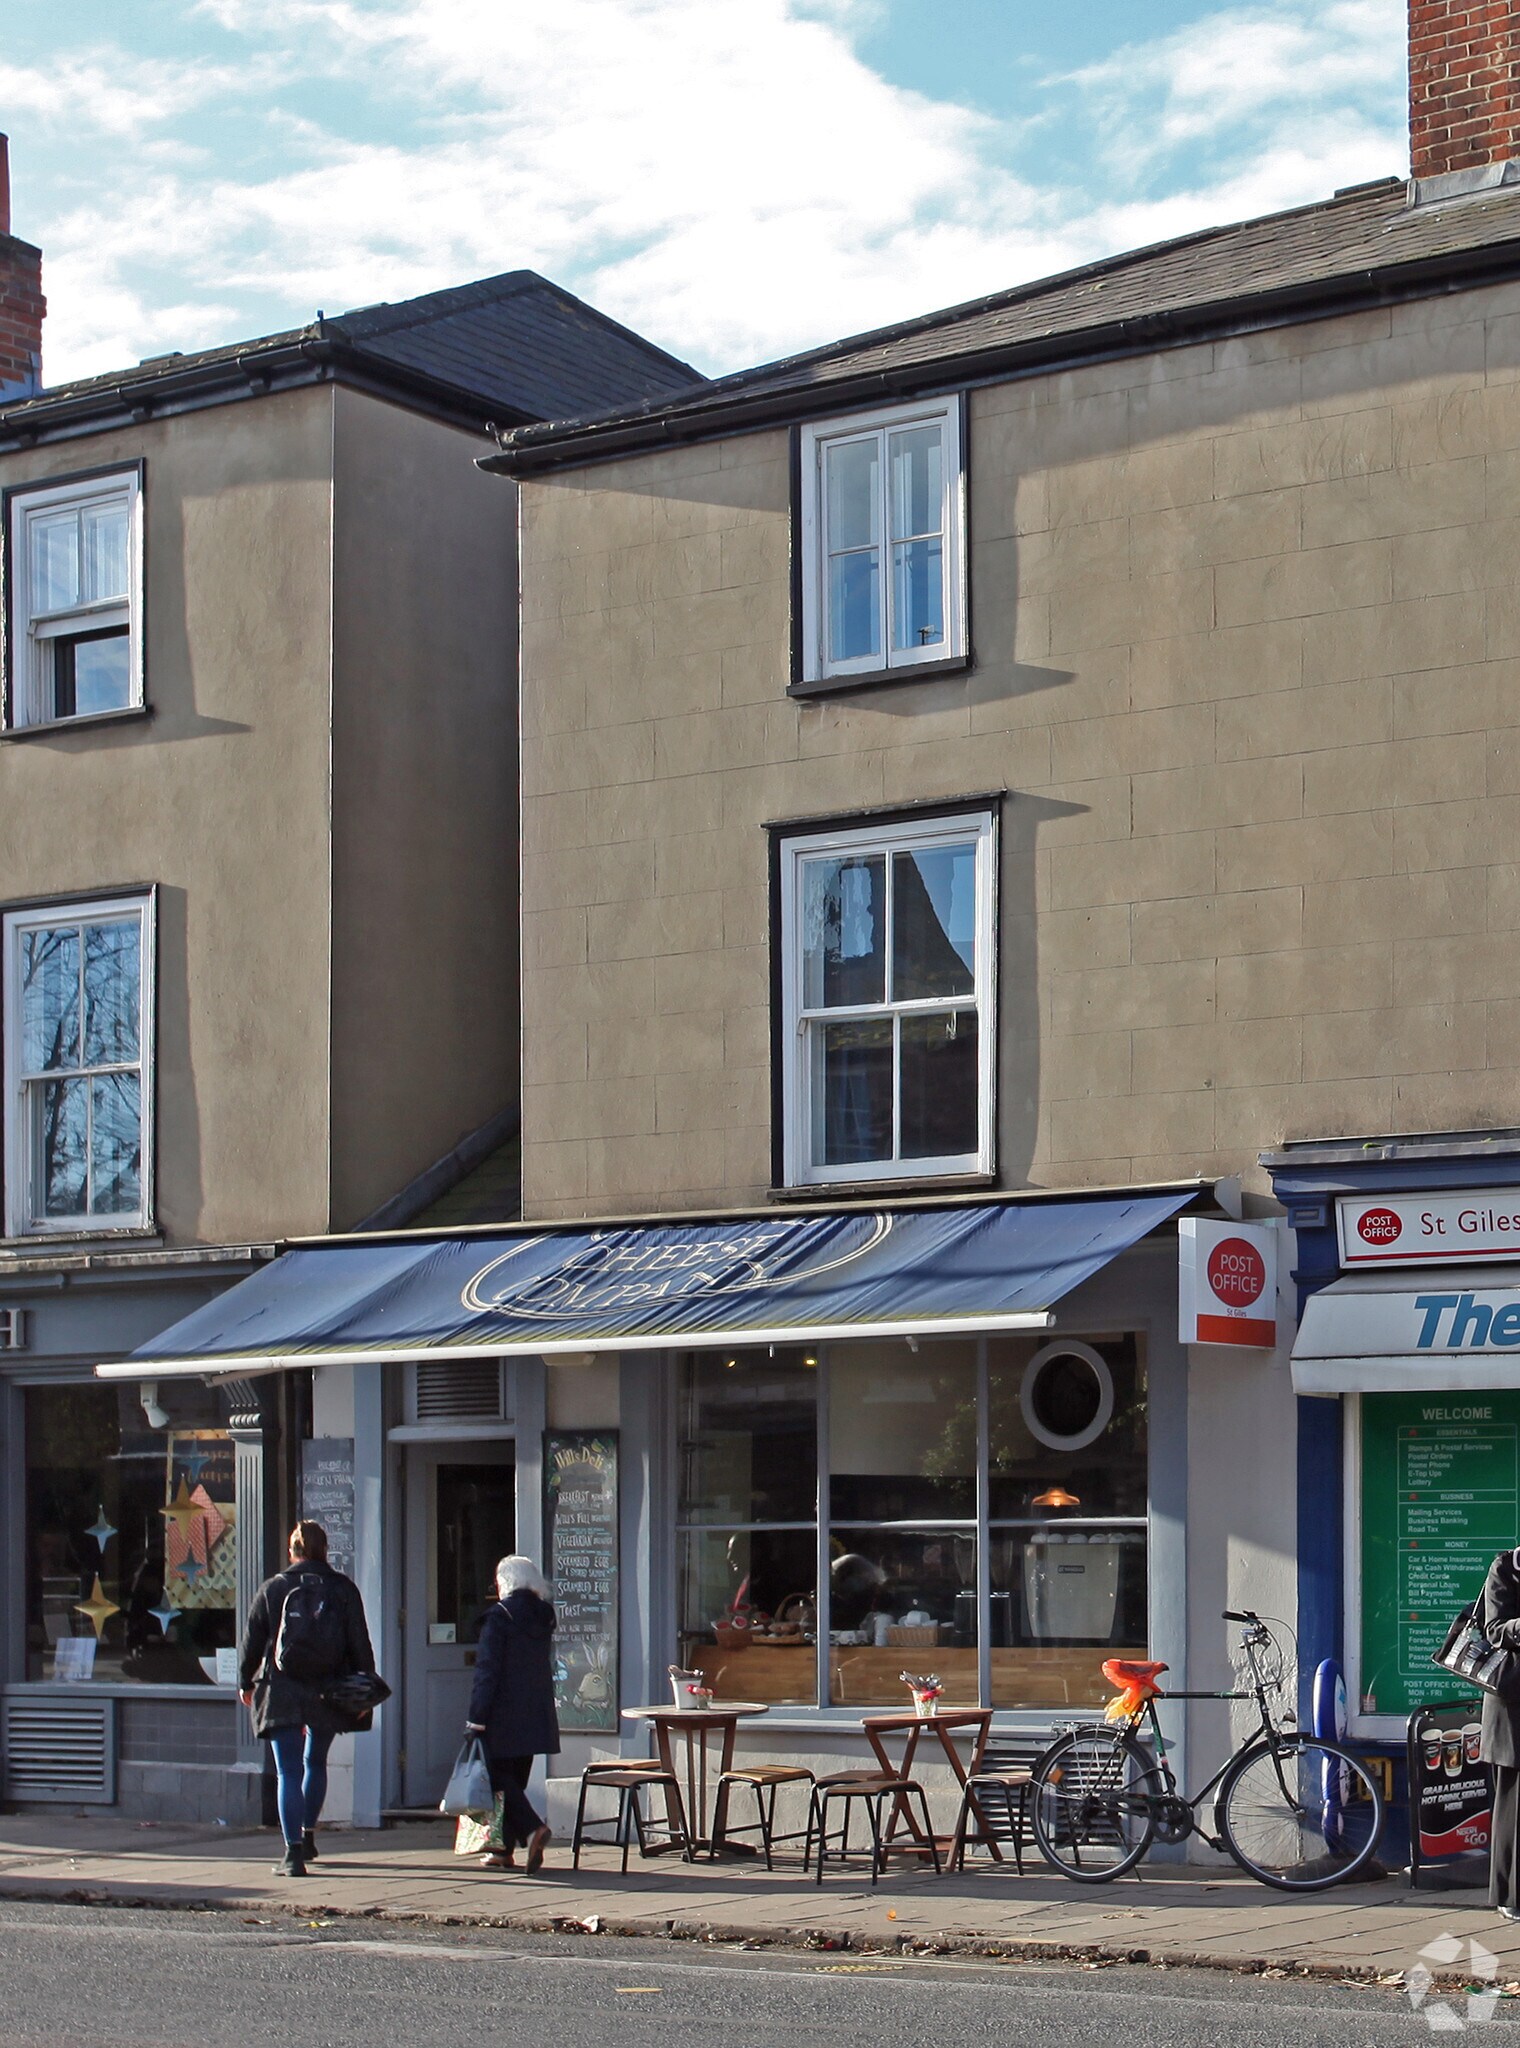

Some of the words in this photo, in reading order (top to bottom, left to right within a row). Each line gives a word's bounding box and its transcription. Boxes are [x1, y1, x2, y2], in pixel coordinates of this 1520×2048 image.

[1366, 1215, 1392, 1227] POST
[1420, 1212, 1447, 1236] St
[1457, 1207, 1520, 1234] Giles
[1362, 1226, 1398, 1238] OFFICE
[559, 1230, 790, 1273] CHEESE
[1220, 1254, 1254, 1273] POST
[1212, 1272, 1258, 1294] OFFICE
[1226, 1308, 1233, 1317] St
[1234, 1308, 1247, 1318] Giles
[1414, 1293, 1520, 1349] The
[1422, 1406, 1493, 1420] WELCOME
[1436, 1428, 1478, 1436] ESSENTIALS
[1408, 1444, 1433, 1452] Stamps
[1463, 1443, 1493, 1451] Services
[554, 1446, 581, 1469] Will's
[581, 1445, 604, 1471] Deli
[1428, 1470, 1442, 1478] Ups
[1408, 1479, 1432, 1487] Lottery
[1408, 1509, 1432, 1517] Mailing
[1433, 1508, 1462, 1516] Services
[1408, 1517, 1439, 1525] Business
[1440, 1517, 1469, 1525] Banking
[556, 1535, 594, 1549] VEGETARIAN
[557, 1555, 591, 1571] SCRAMBLED
[594, 1556, 610, 1568] EGGS
[1443, 1564, 1485, 1572] Withdrawals
[557, 1581, 592, 1596] SCRAMBLED
[594, 1581, 610, 1593] EGGS
[1408, 1581, 1437, 1589] Personal
[1421, 1590, 1453, 1598] Payments
[1408, 1598, 1432, 1606] Saving
[558, 1603, 582, 1619] TOAST
[1408, 1637, 1434, 1645] Foreign
[1403, 1680, 1423, 1688] POST
[1424, 1680, 1450, 1688] OFFICE
[1422, 1786, 1443, 1796] GRAB
[1443, 1785, 1449, 1793] A
[1450, 1778, 1485, 1793] DELICIOUS
[1421, 1796, 1438, 1806] HOT
[1461, 1788, 1487, 1800] SERVED
[1444, 1801, 1463, 1812] HERE
